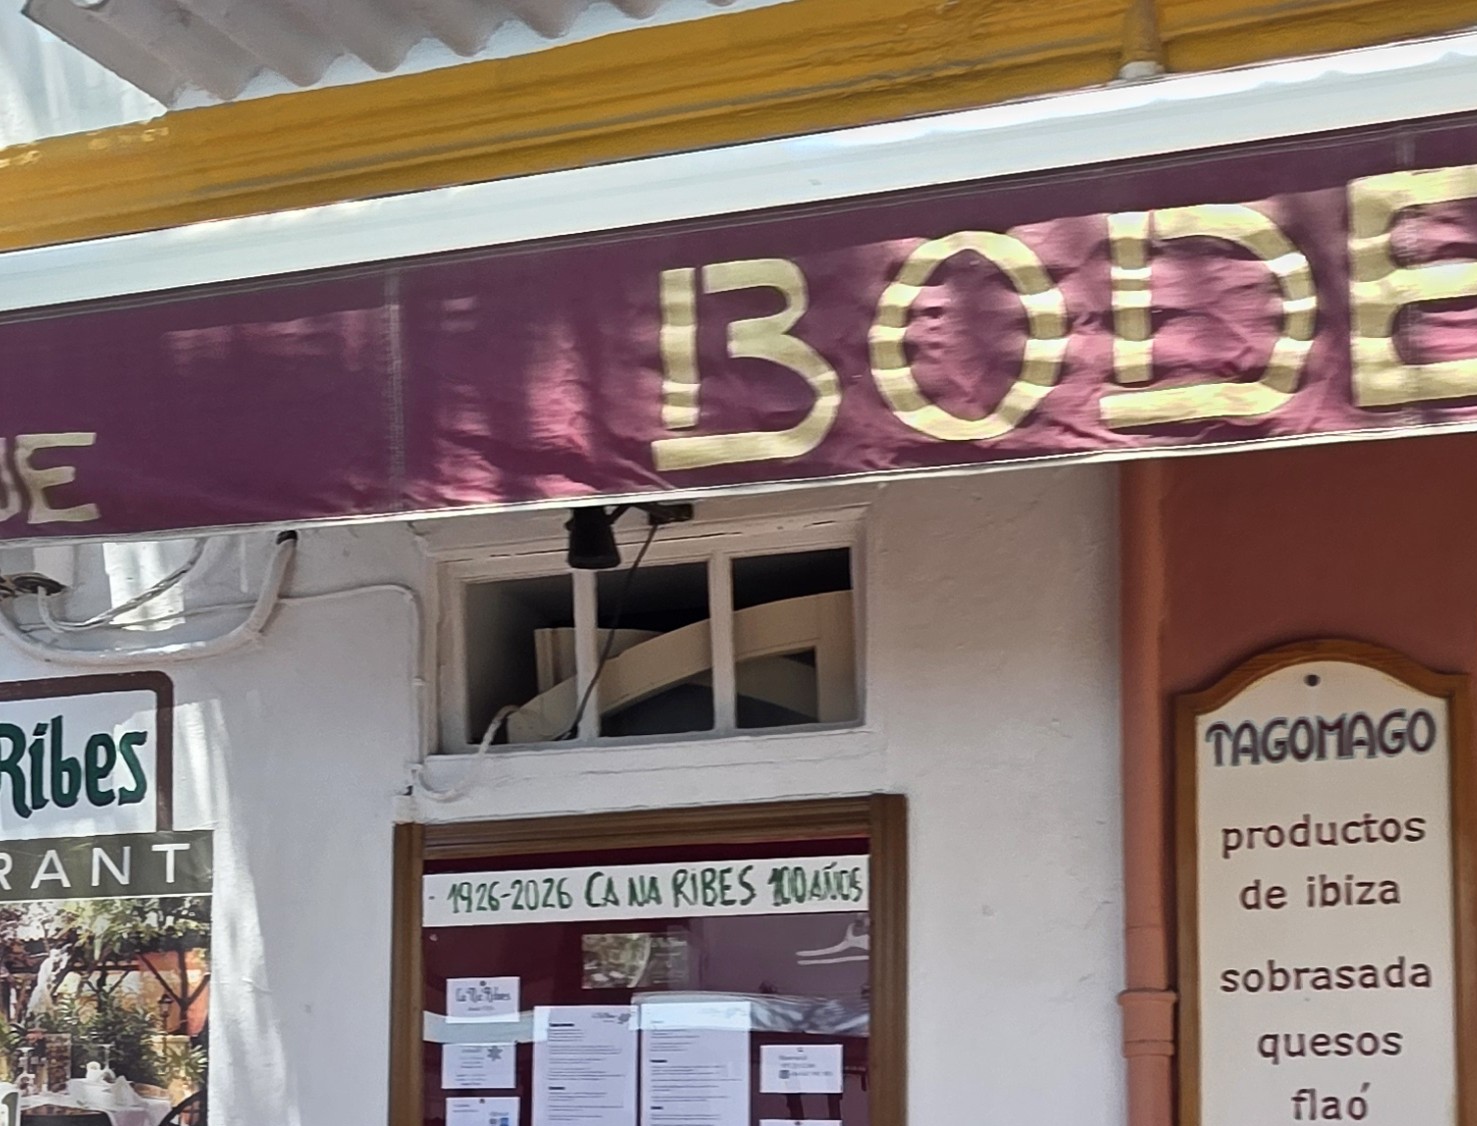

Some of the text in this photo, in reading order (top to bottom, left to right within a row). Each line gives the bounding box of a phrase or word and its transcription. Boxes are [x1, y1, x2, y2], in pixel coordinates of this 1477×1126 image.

[0, 432, 100, 523] E
[1205, 708, 1438, 767] TAGOMAGO
[0, 715, 148, 819] Ribes
[1221, 813, 1427, 859] productos
[448, 877, 573, 913] 1926-2026
[584, 872, 619, 908] CA
[628, 875, 662, 907] NA
[1239, 874, 1401, 910] de ibiza
[1220, 956, 1432, 993] sobrasada
[1257, 1031, 1404, 1065] quesos
[1291, 1082, 1371, 1121] flaó
